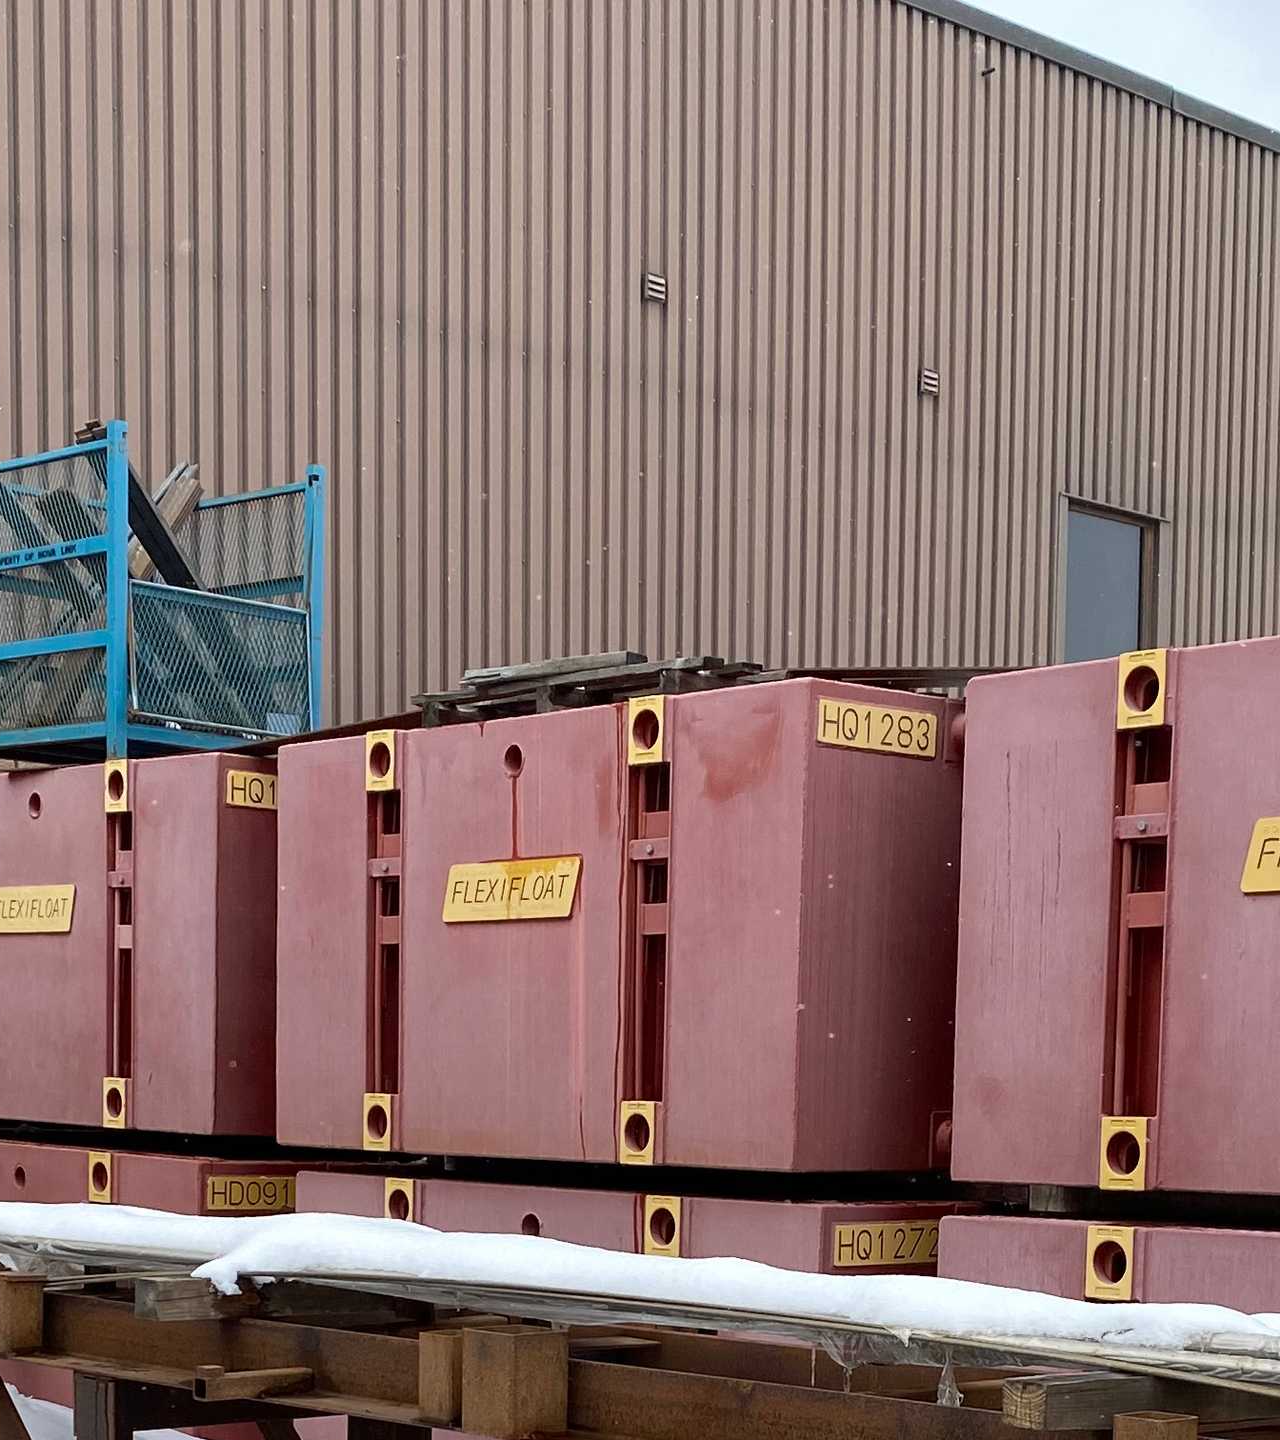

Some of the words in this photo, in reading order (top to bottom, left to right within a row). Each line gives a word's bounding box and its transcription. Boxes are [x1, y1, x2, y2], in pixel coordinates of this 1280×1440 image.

[822, 704, 930, 751] HQ1283
[451, 873, 570, 904] FLEXIFLOAT
[211, 1179, 290, 1206] HD091
[838, 1226, 939, 1262] HQ1272
